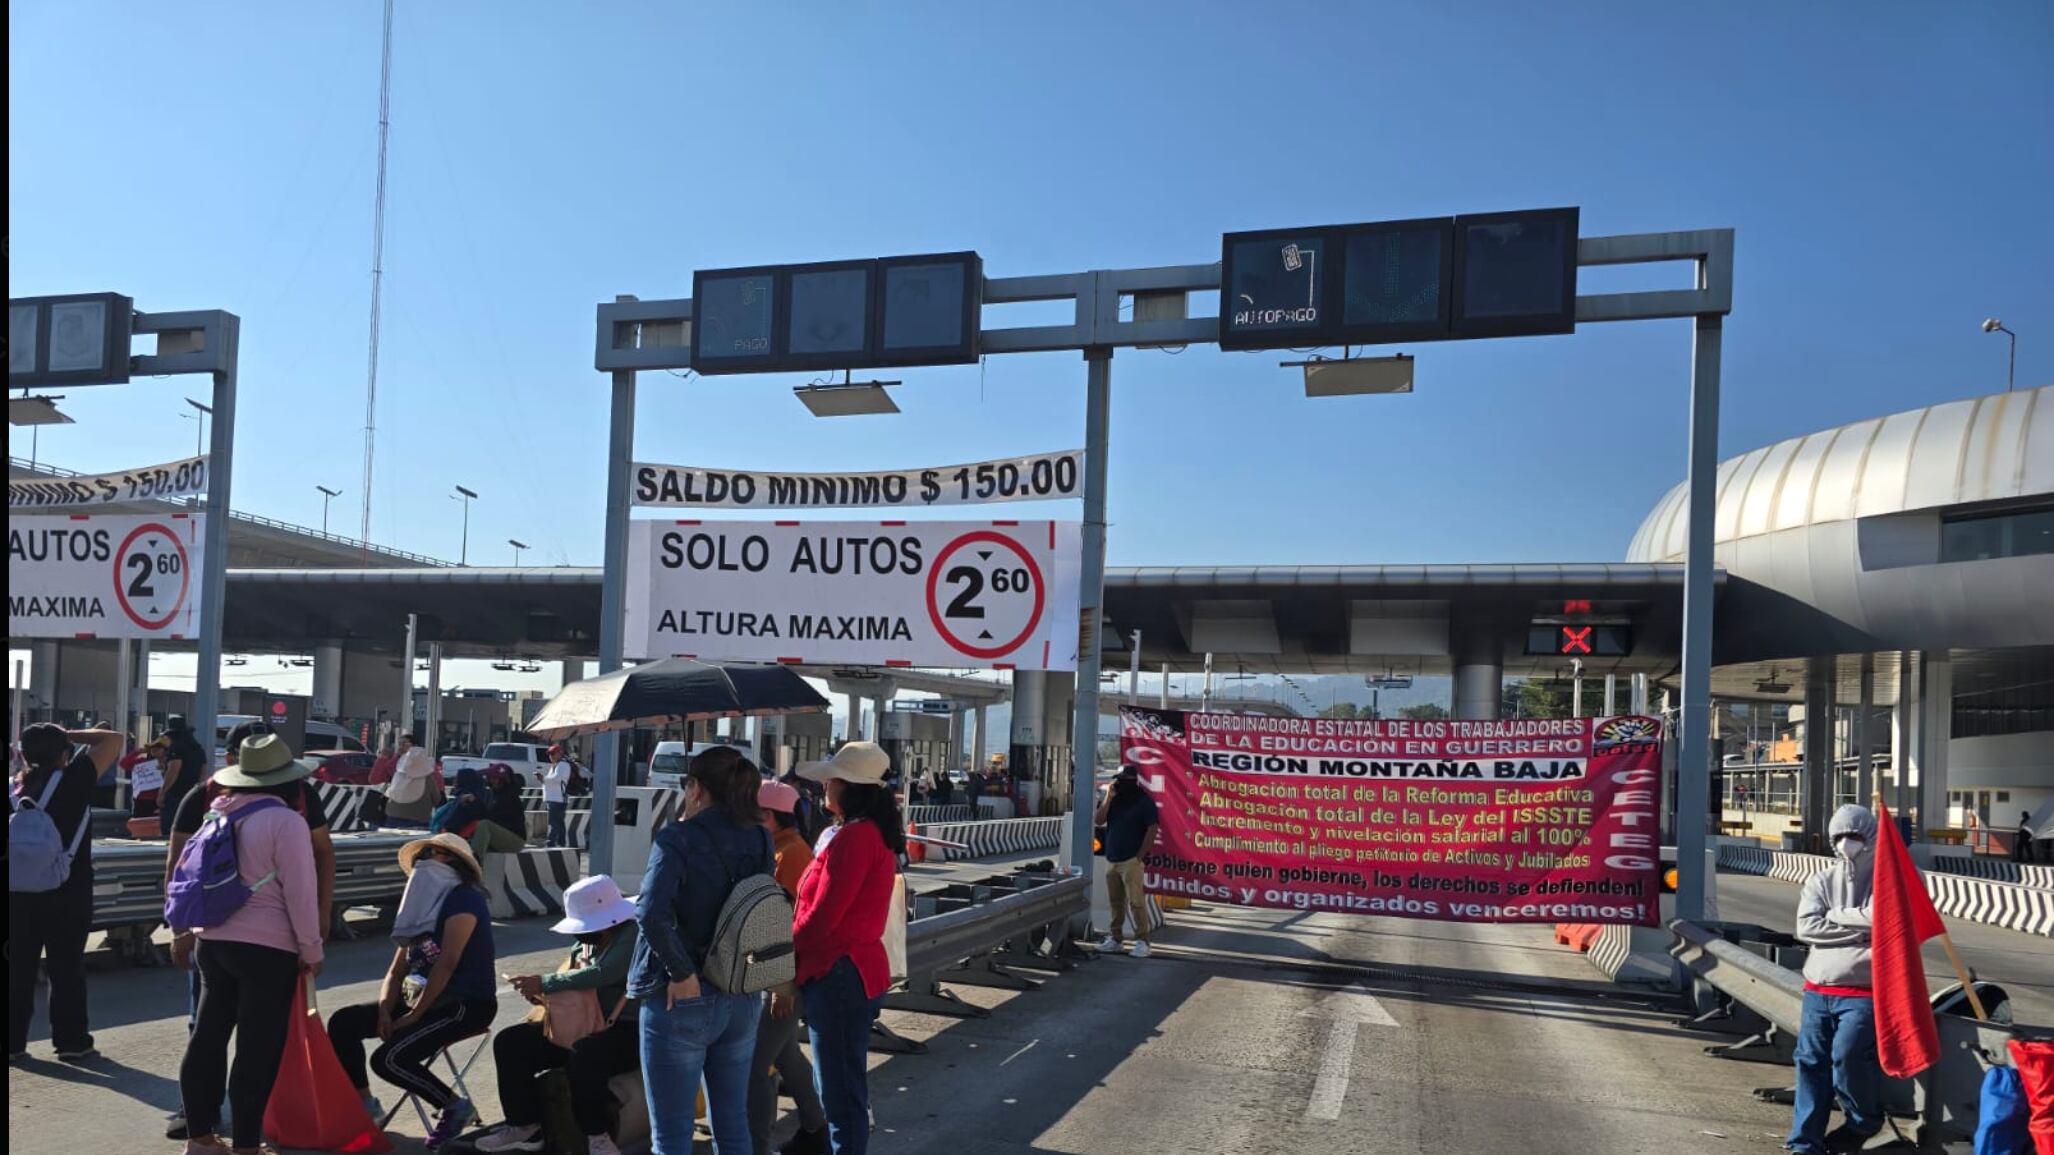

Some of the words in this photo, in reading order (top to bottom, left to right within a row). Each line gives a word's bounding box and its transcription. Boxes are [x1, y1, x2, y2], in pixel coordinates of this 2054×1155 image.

[123, 460, 204, 499] 150.00
[636, 467, 756, 504] SALDO
[767, 474, 907, 505] MINIMO
[920, 470, 941, 505] $
[953, 456, 1076, 500] 150.00
[9, 529, 111, 562] AUTOS
[660, 531, 769, 572] SOLO
[790, 536, 923, 575] AUTOS
[127, 553, 154, 597] 2
[156, 553, 181, 575] 60
[945, 566, 984, 618] 2
[991, 568, 1029, 593] 60
[9, 596, 105, 618] MAXIMA
[657, 609, 780, 638] ALTURA
[789, 614, 912, 642] MAXIMA
[1190, 713, 1311, 735] COORDINADORA
[1315, 720, 1385, 737] ESTATAL
[1387, 722, 1410, 738] DE
[1414, 722, 1446, 738] LOS
[1450, 719, 1584, 738] TRABAJADORES
[1191, 731, 1219, 744] DE
[1225, 736, 1252, 748] LA
[1260, 736, 1396, 754] EDUCACIÓN
[1405, 741, 1437, 754] EN
[1445, 738, 1582, 754] GUERRERO
[1192, 751, 1308, 774] REGIÓN
[1319, 758, 1484, 778] MONTAÑA
[1494, 761, 1582, 779] BAJA
[1198, 773, 1298, 799] Abrogación
[1304, 785, 1347, 801] total
[1353, 786, 1376, 802] de
[1382, 786, 1400, 803] la
[1406, 786, 1488, 804] Reforma
[1495, 786, 1594, 804] Educativa
[1199, 791, 1309, 820] Abrogación
[1316, 806, 1363, 823] total
[1370, 808, 1395, 824] de
[1402, 808, 1421, 824] la
[1428, 810, 1467, 828] Ley
[1473, 810, 1505, 824] del
[1512, 808, 1593, 824] ISSSTE
[1604, 769, 1655, 869] CETEG
[1200, 810, 1303, 835] Incremento
[1309, 826, 1319, 839] y
[1326, 826, 1425, 843] nivelación
[1431, 828, 1505, 844] salarial
[1511, 828, 1528, 843] al
[1536, 828, 1592, 846] 100%
[1194, 831, 1288, 853] Cumplimiento
[1292, 844, 1304, 856] al
[1309, 844, 1351, 862] pliego
[1356, 848, 1418, 863] petitorio
[1422, 849, 1440, 862] de
[1444, 849, 1500, 866] Activos
[1504, 853, 1514, 871] y
[1518, 851, 1591, 869] Jubilados
[1143, 872, 1232, 899] Unidos
[1240, 888, 1256, 904] y
[1264, 889, 1440, 915] organizados
[1450, 901, 1647, 921] venceremos!
[1223, 862, 1273, 880] quien
[1279, 866, 1368, 890] gobierne,
[1374, 870, 1401, 888] los
[1408, 874, 1500, 894] derechos
[1506, 880, 1530, 896] se
[1536, 877, 1644, 897] defienden!
